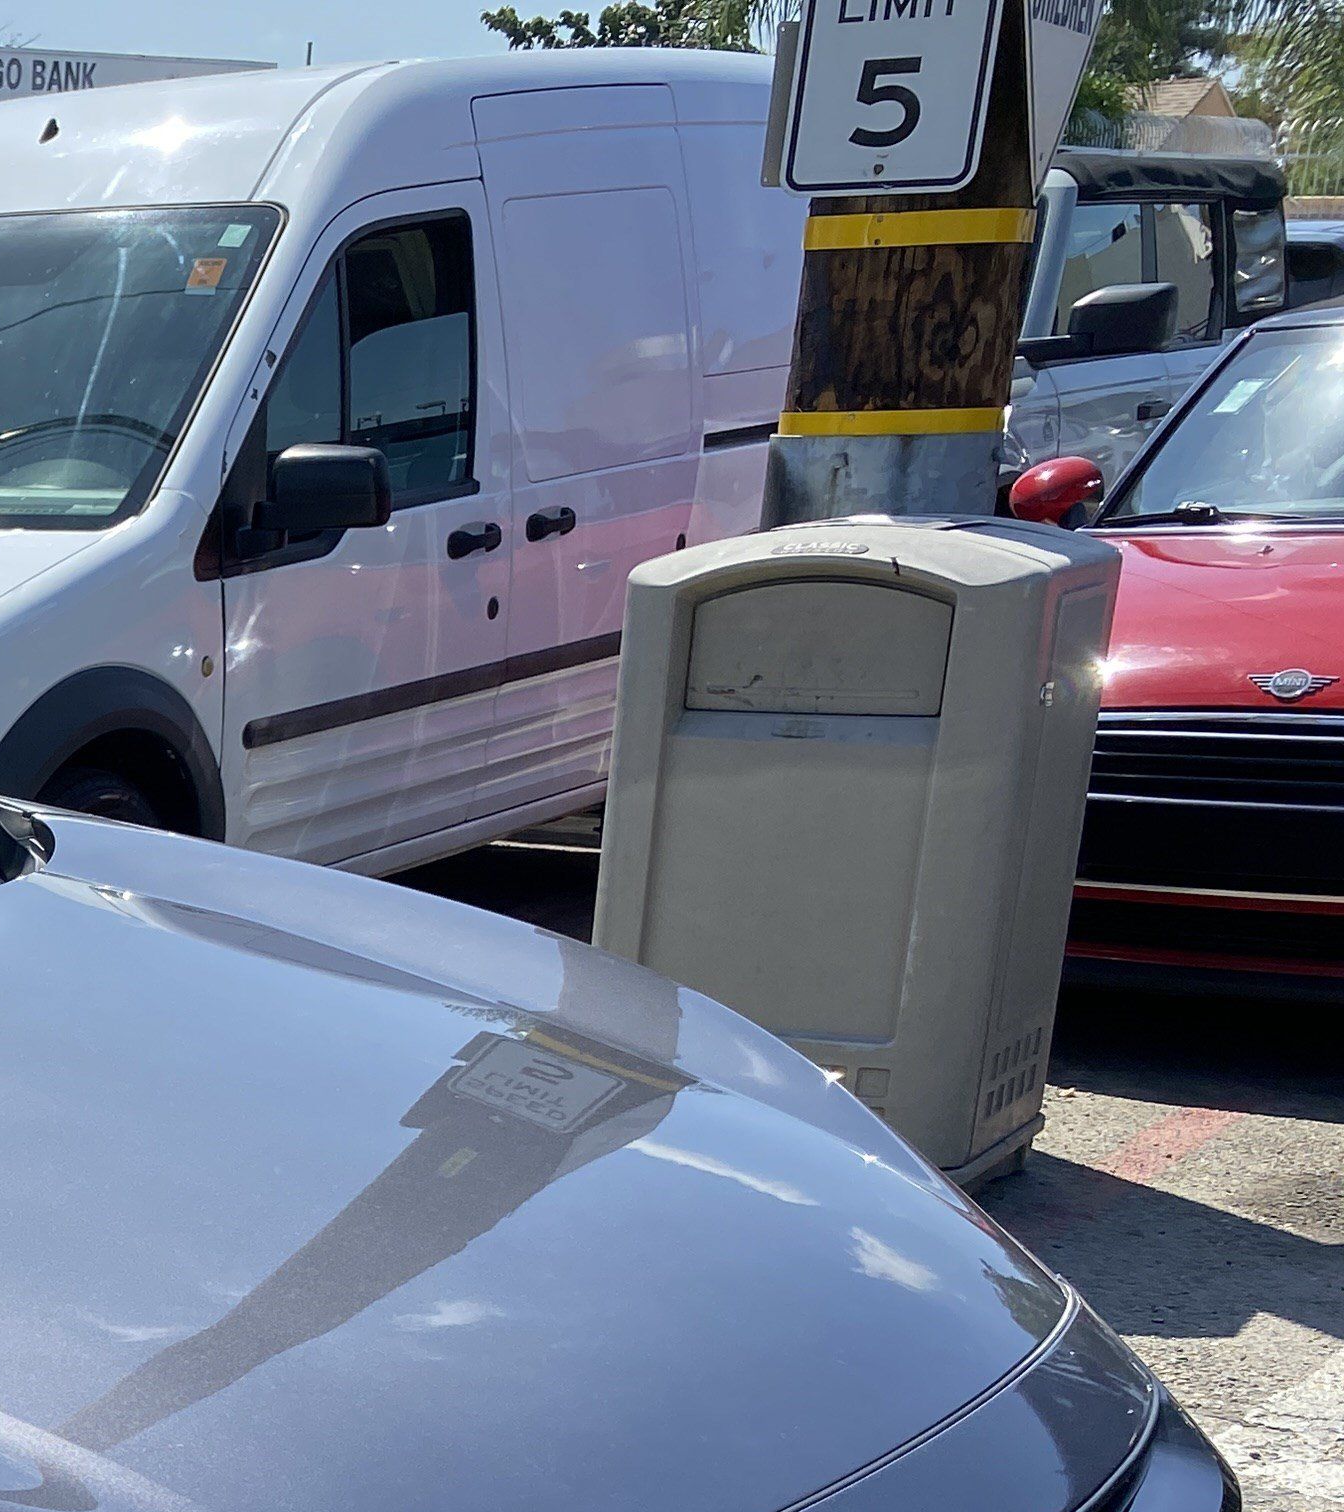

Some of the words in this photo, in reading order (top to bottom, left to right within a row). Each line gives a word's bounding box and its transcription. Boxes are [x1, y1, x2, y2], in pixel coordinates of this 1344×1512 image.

[31, 59, 97, 92] BANK
[848, 56, 922, 148] 5
[1275, 677, 1307, 686] MINI
